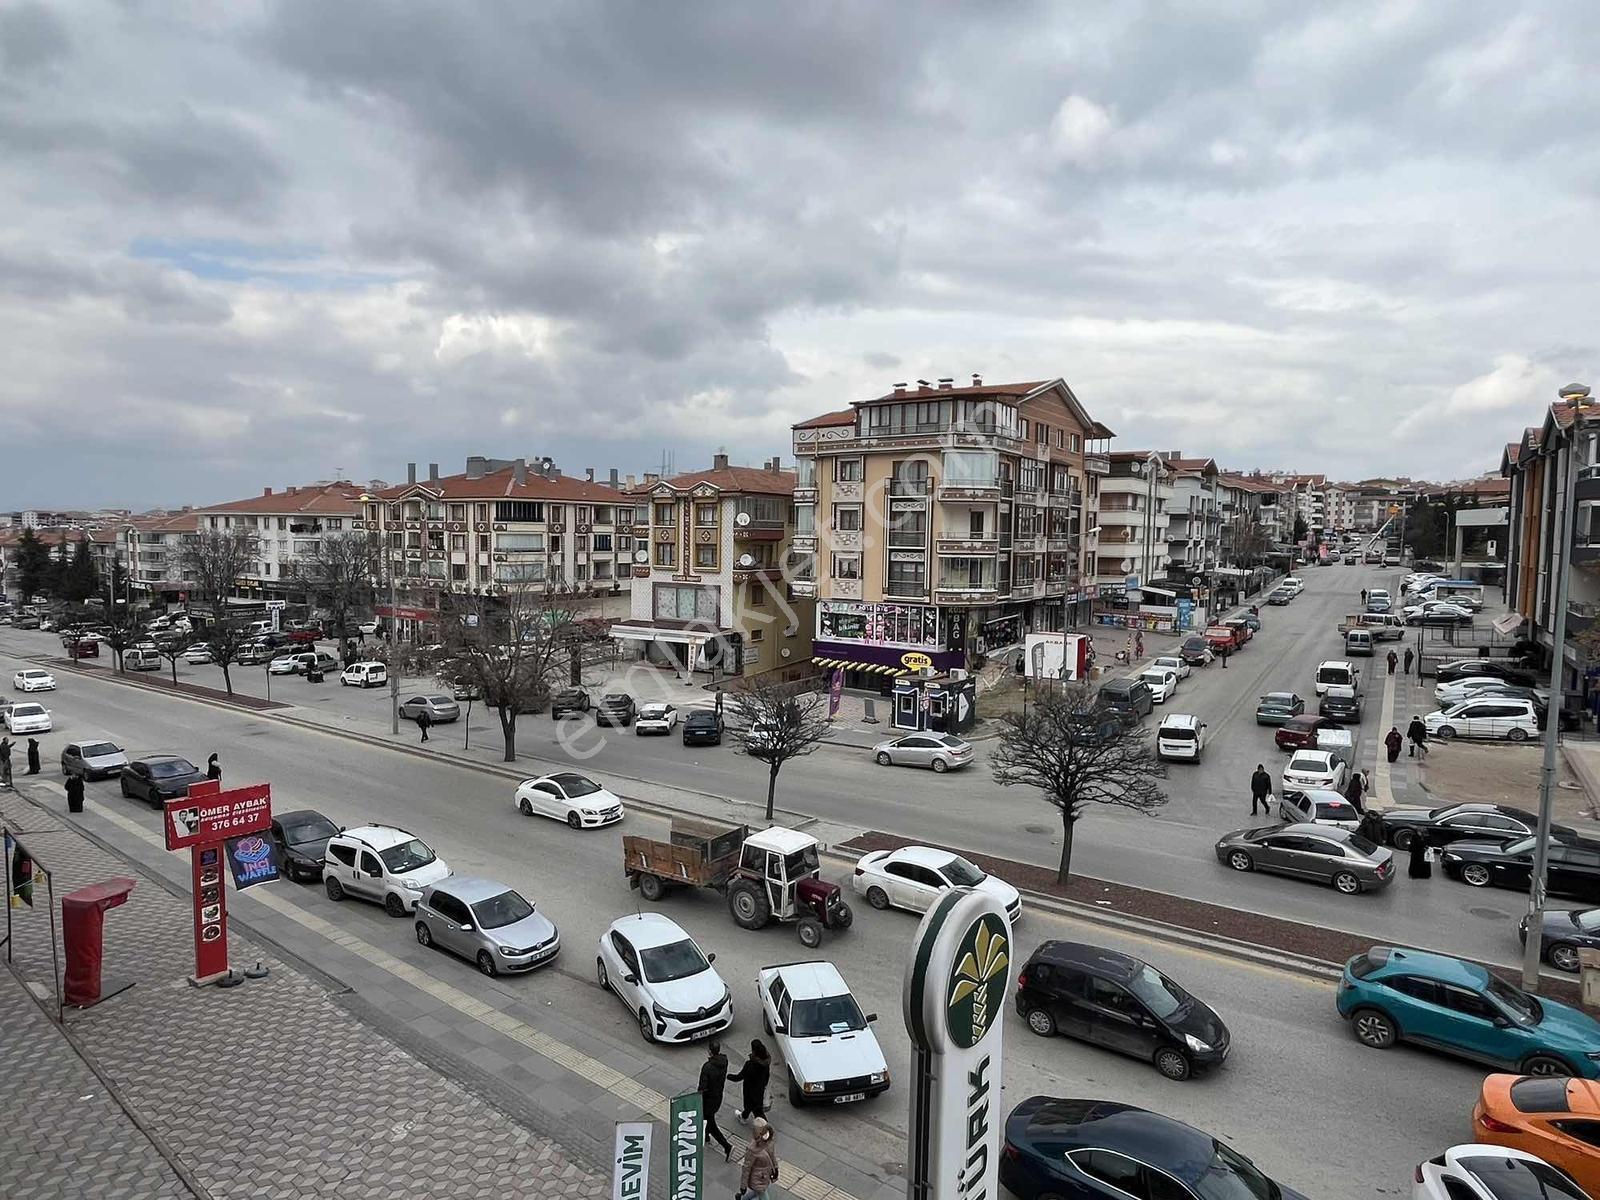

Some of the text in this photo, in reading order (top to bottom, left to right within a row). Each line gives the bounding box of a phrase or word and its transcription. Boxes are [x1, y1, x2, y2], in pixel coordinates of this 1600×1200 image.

[903, 655, 928, 666] gratis
[200, 797, 267, 817] ÖMER AYBAK
[211, 813, 259, 831] 376 64 37
[237, 865, 276, 881] WAFFLE
[957, 1053, 990, 1200] ÜRK
[616, 1135, 645, 1200] EVİM
